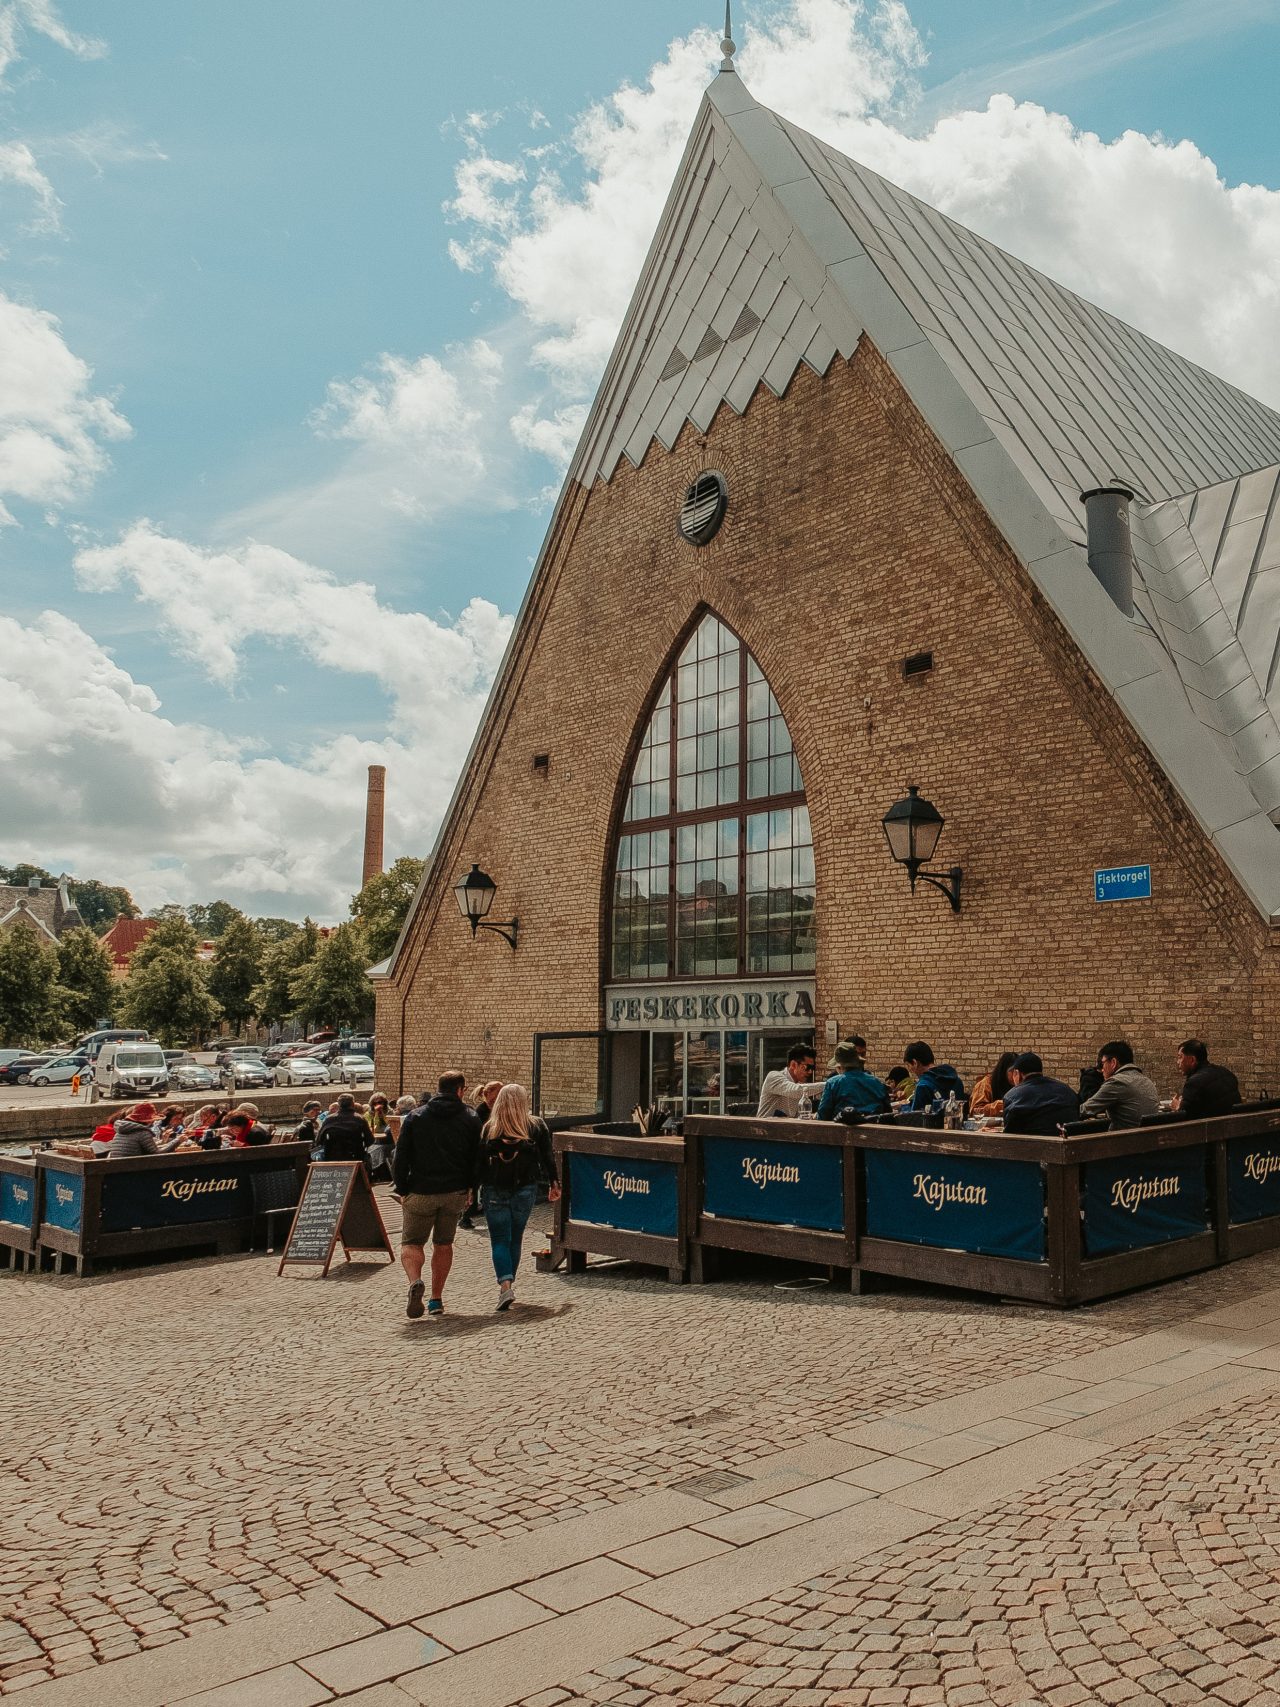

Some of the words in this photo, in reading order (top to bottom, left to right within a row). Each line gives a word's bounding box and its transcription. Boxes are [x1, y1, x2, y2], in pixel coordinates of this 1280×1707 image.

[1097, 870, 1147, 884] Fisktorget
[1099, 887, 1105, 898] 3
[610, 991, 814, 1020] FESKEKORKA
[603, 1170, 650, 1199] Kajutan
[742, 1157, 800, 1190] Kajutan
[160, 1177, 239, 1202] Kajutan
[913, 1174, 988, 1211] Kajutan
[1111, 1175, 1181, 1213] Kajutan
